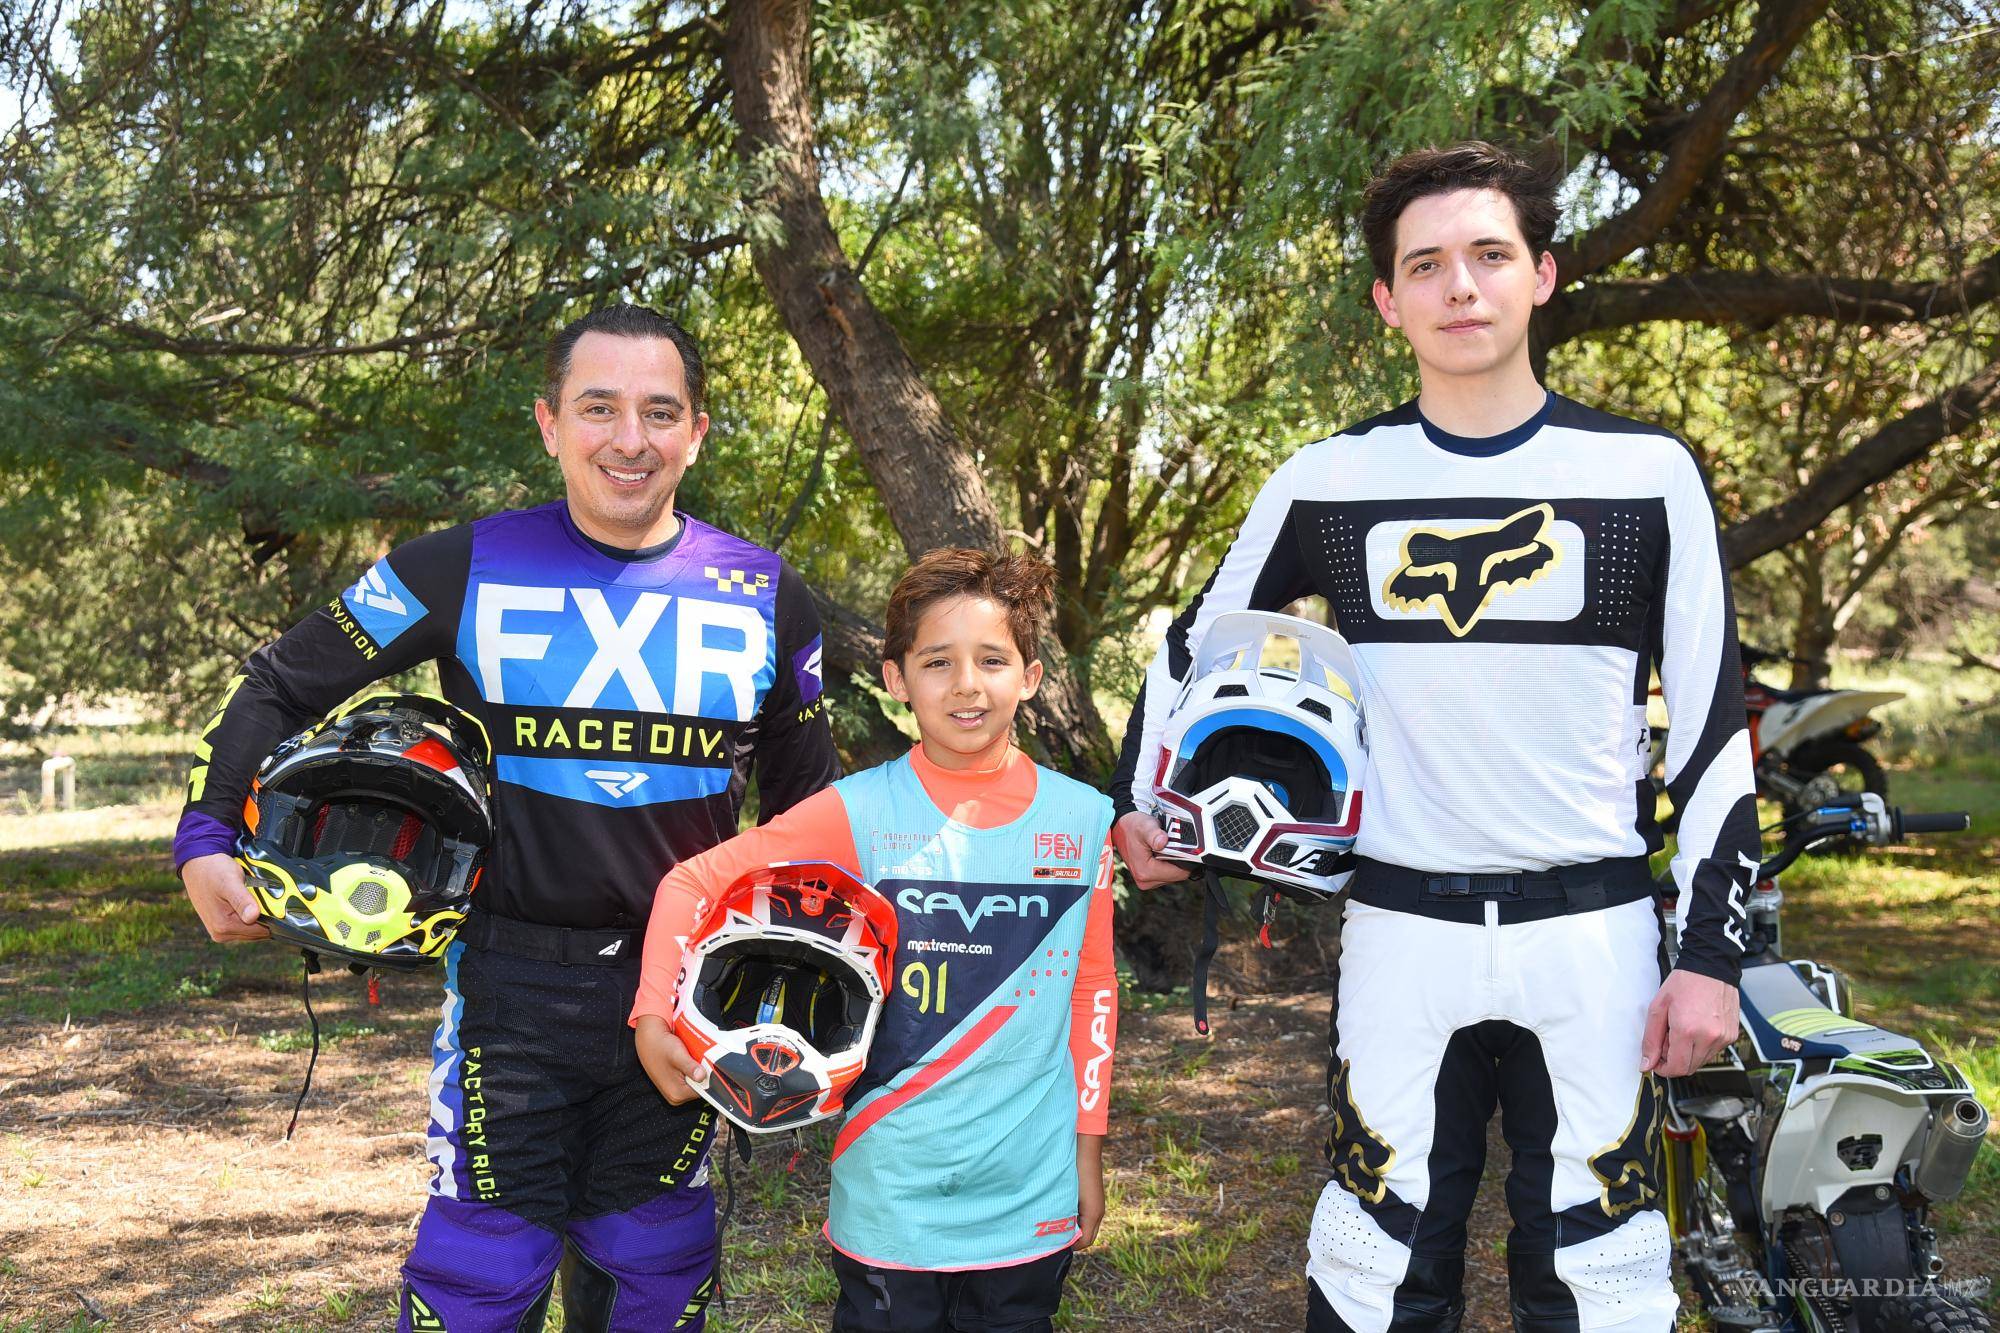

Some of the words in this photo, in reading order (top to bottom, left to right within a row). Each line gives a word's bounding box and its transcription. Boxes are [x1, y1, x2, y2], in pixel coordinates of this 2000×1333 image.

[476, 583, 767, 721] FXR
[515, 716, 634, 752] RACE
[649, 723, 725, 759] DIV.
[907, 938, 993, 955] mpxtreme.com
[901, 960, 948, 1015] 91
[464, 1046, 488, 1148] FACTORY
